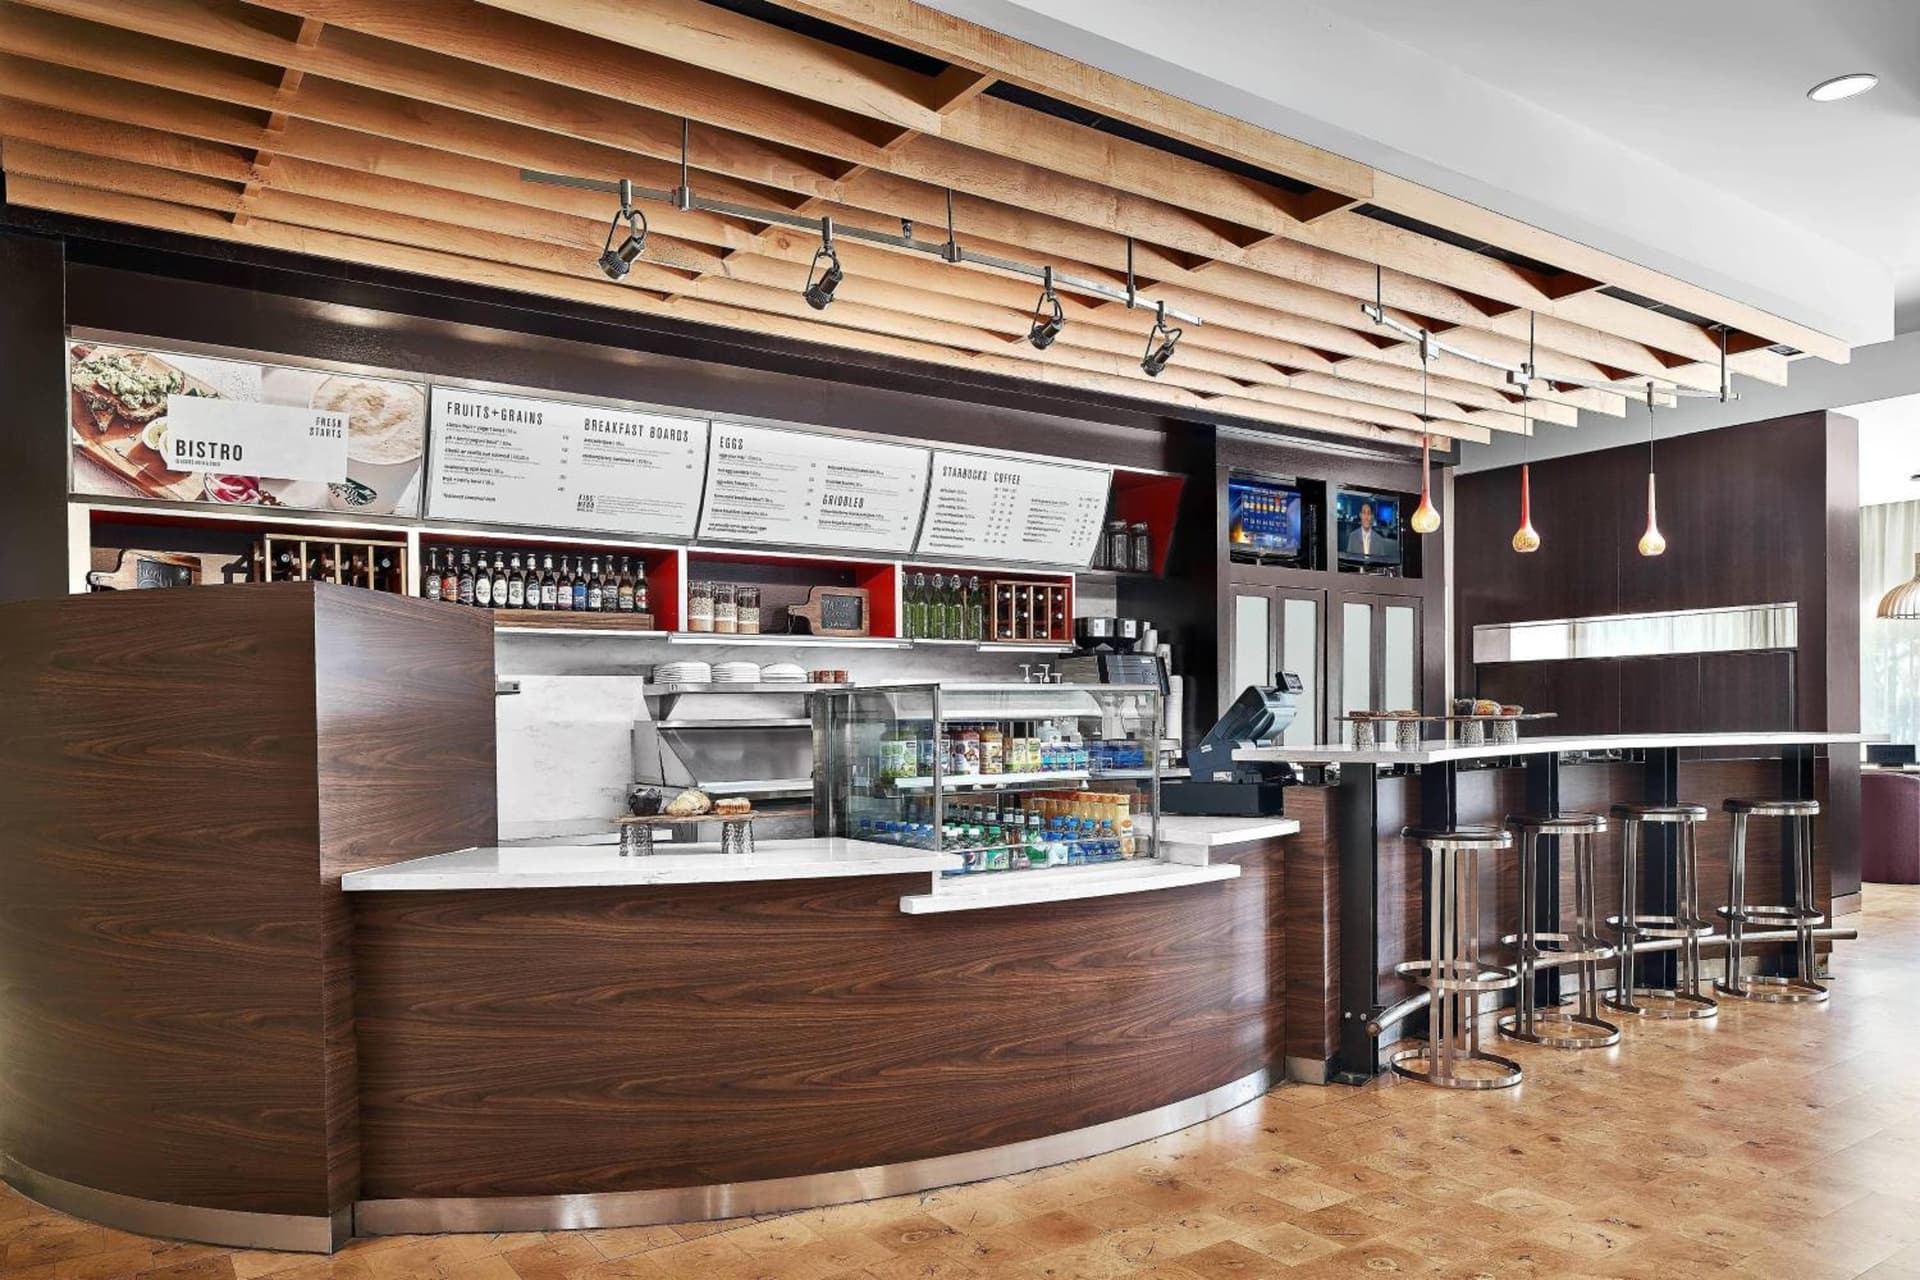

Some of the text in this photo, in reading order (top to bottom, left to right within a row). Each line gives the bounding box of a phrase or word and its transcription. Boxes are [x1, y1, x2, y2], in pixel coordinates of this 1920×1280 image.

[447, 401, 543, 426] FRUITS+GRAINS
[309, 426, 342, 439] STARTS
[584, 418, 689, 442] BREAKFAST BOARDS
[175, 439, 243, 461] BISTRO
[719, 436, 743, 450] EGGS
[994, 472, 1021, 485] COFFEE
[822, 494, 865, 509] GRIDDLES
